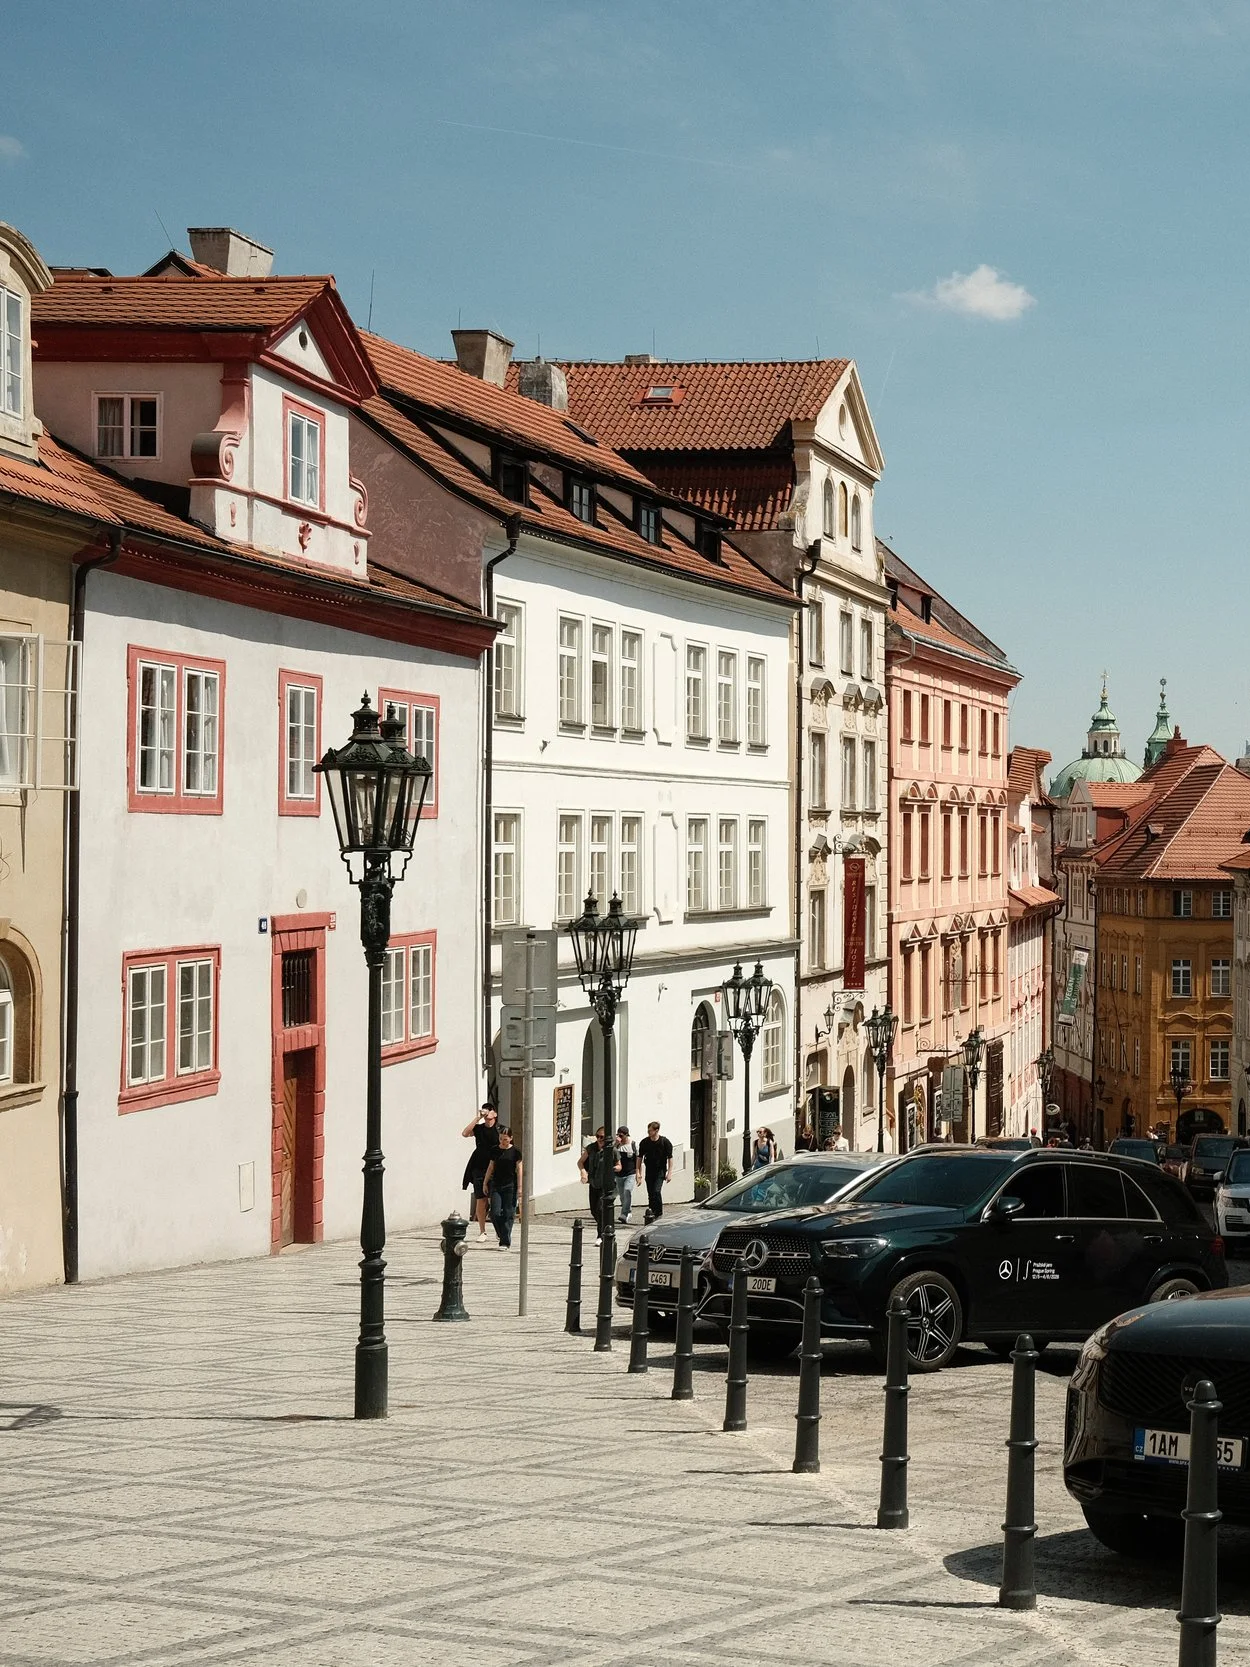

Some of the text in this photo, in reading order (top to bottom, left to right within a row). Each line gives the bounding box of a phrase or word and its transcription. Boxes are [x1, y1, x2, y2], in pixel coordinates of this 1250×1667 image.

[850, 948, 858, 979] HOTEL
[1064, 977, 1076, 1001] VEGAN
[650, 1273, 668, 1285] C463
[1135, 1445, 1144, 1453] CZ
[1150, 1433, 1179, 1457] 1AM
